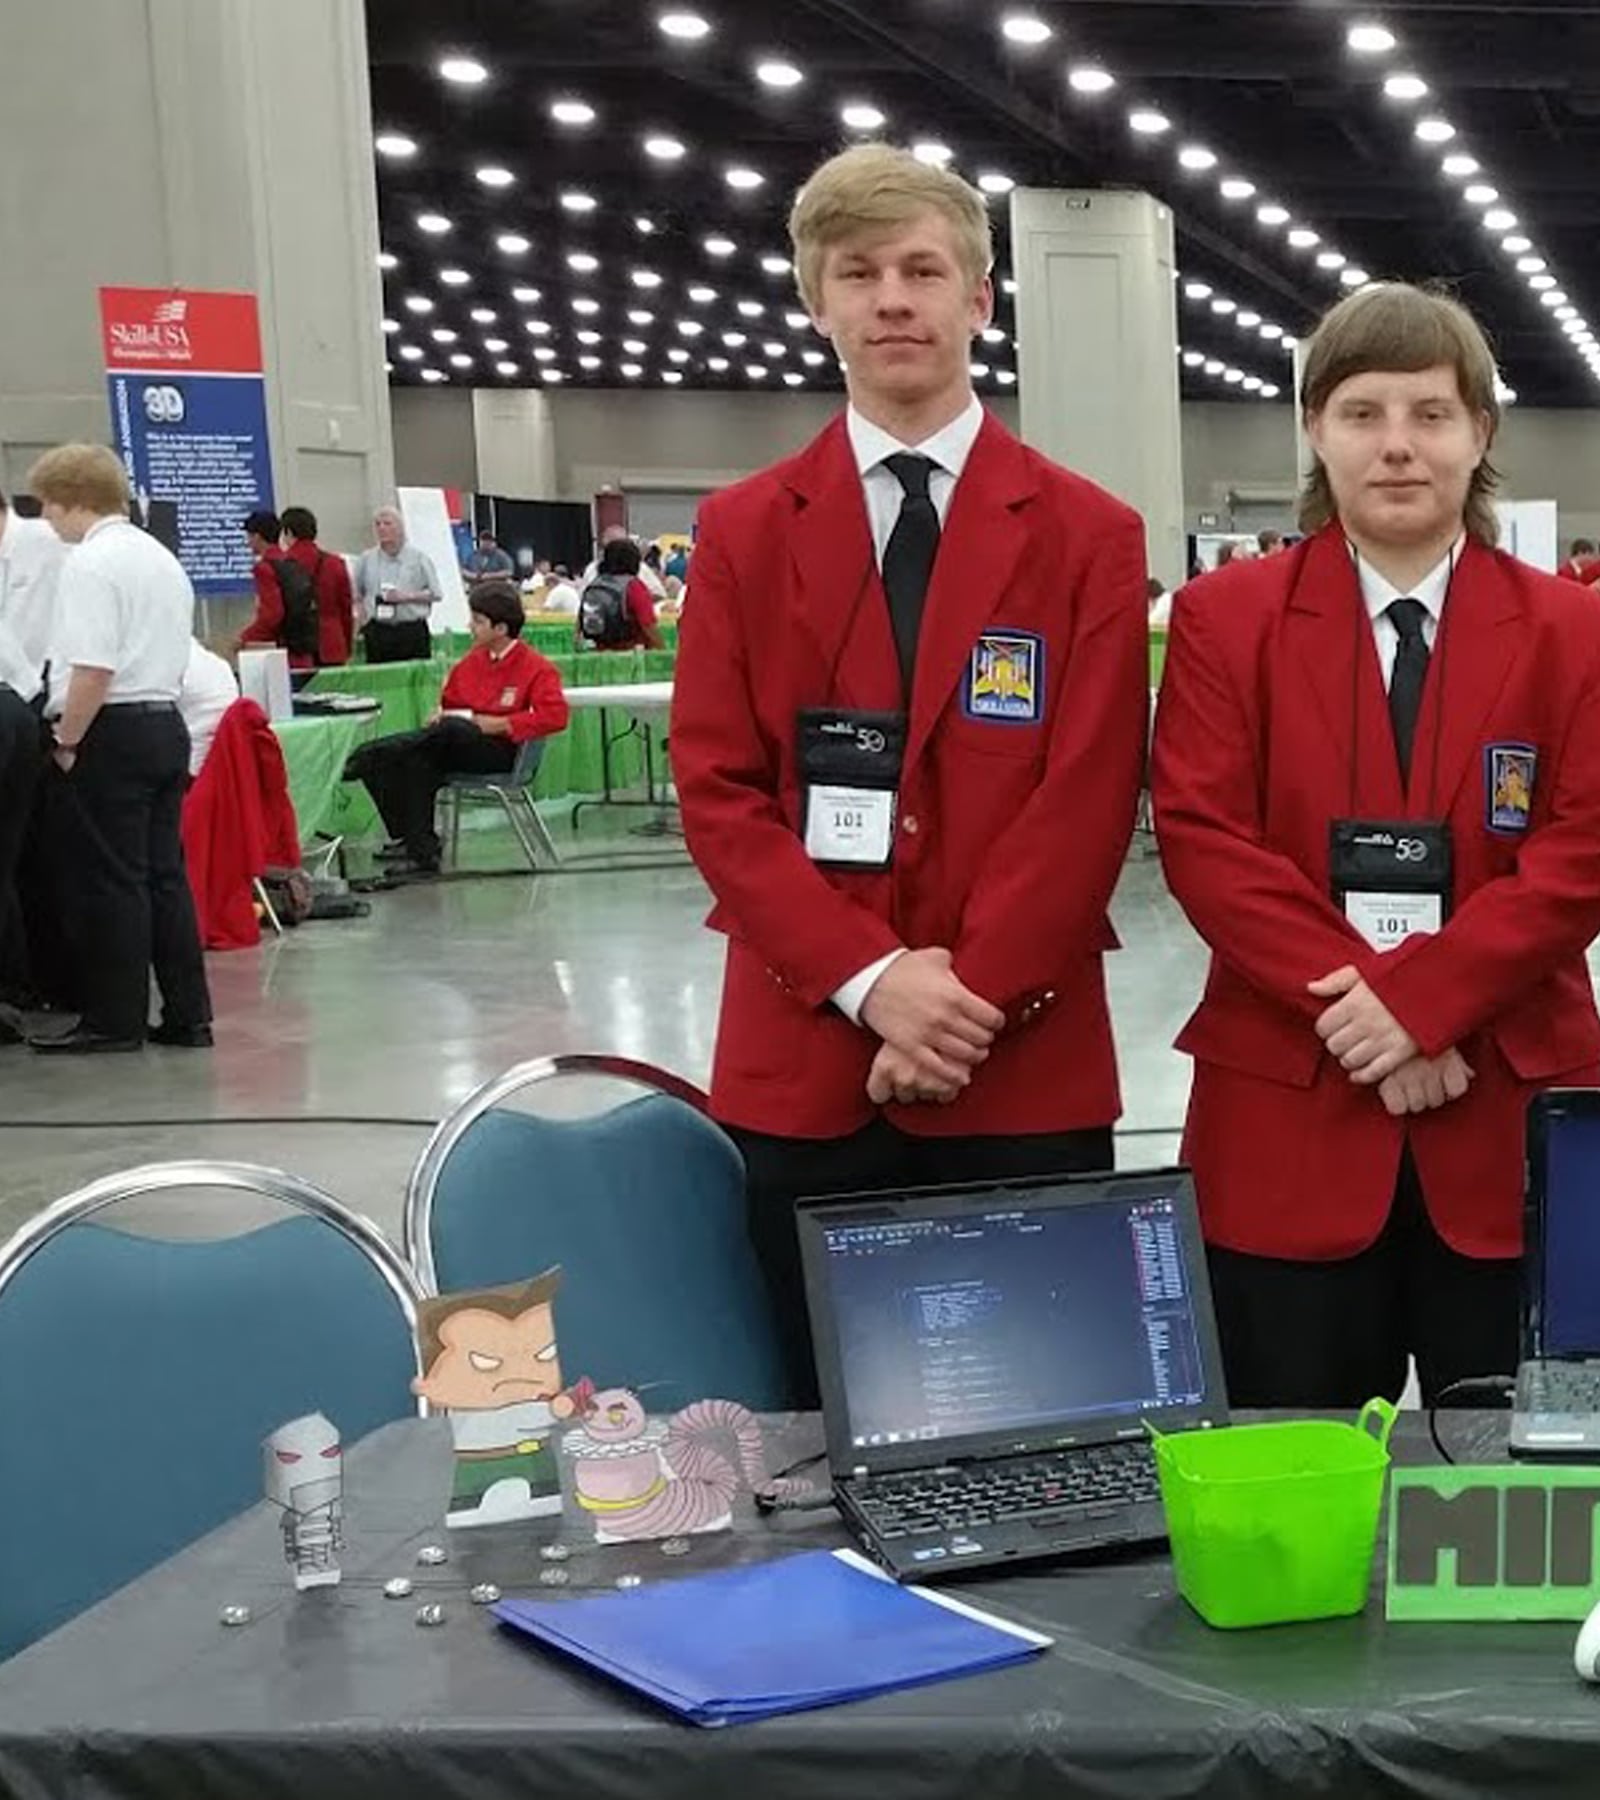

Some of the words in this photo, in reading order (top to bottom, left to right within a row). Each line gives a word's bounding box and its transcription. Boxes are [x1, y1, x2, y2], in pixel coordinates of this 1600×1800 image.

[143, 385, 184, 422] 3D
[833, 812, 863, 827] 101
[1376, 918, 1410, 933] 101
